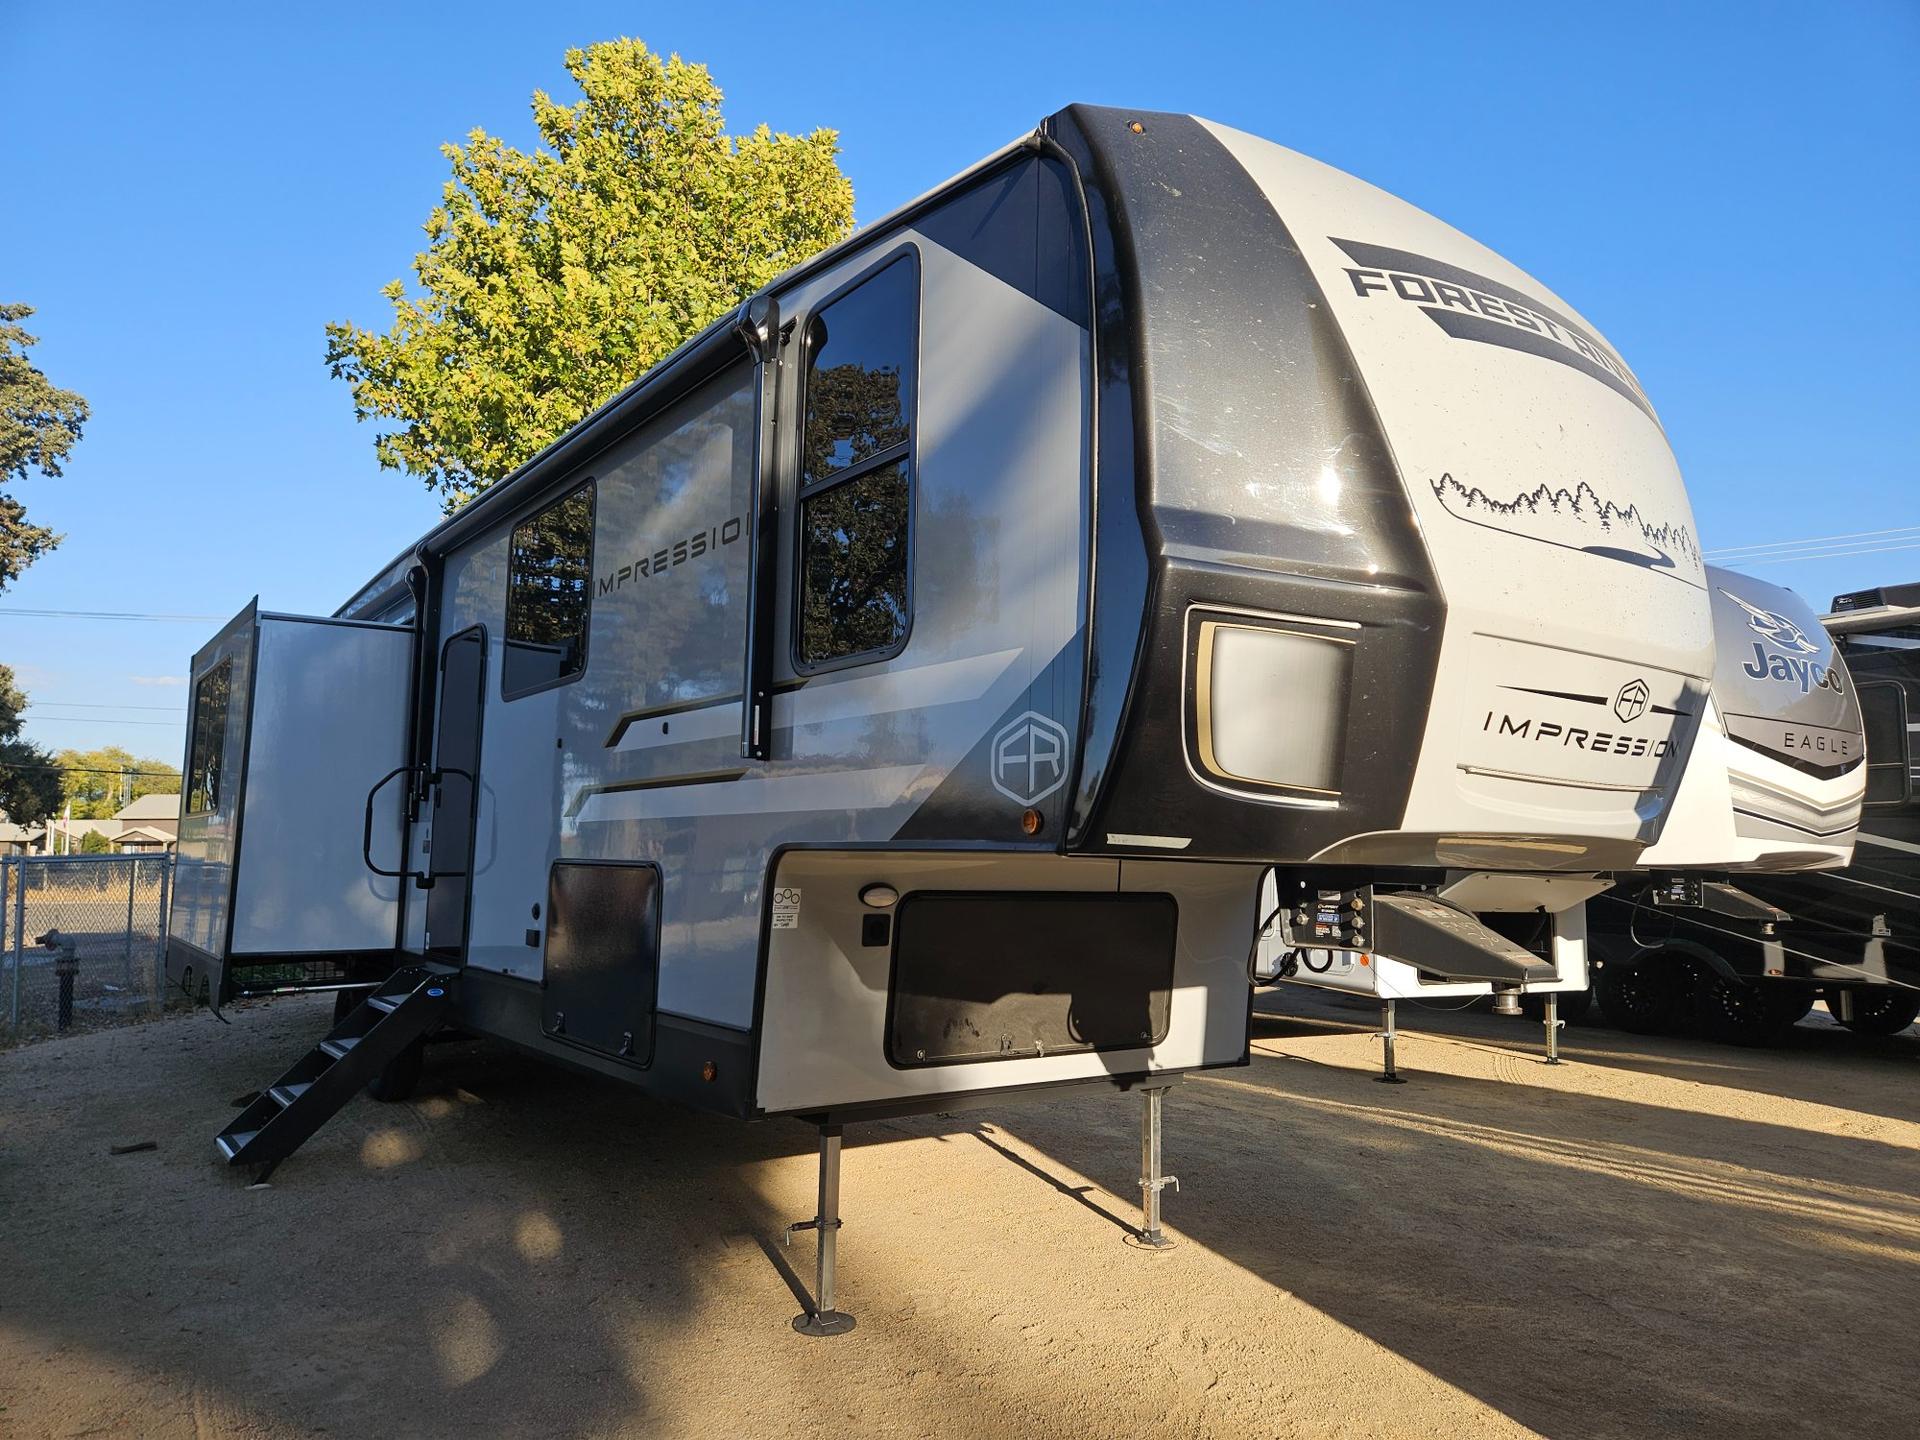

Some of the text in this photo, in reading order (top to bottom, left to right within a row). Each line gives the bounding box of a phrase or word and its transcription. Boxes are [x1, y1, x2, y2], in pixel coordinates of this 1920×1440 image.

[1342, 267, 1561, 341] FOREST
[1742, 642, 1844, 695] Jayco
[998, 724, 1060, 793] FR
[1484, 711, 1681, 758] IMPRESSION
[1784, 732, 1849, 755] EAGLE
